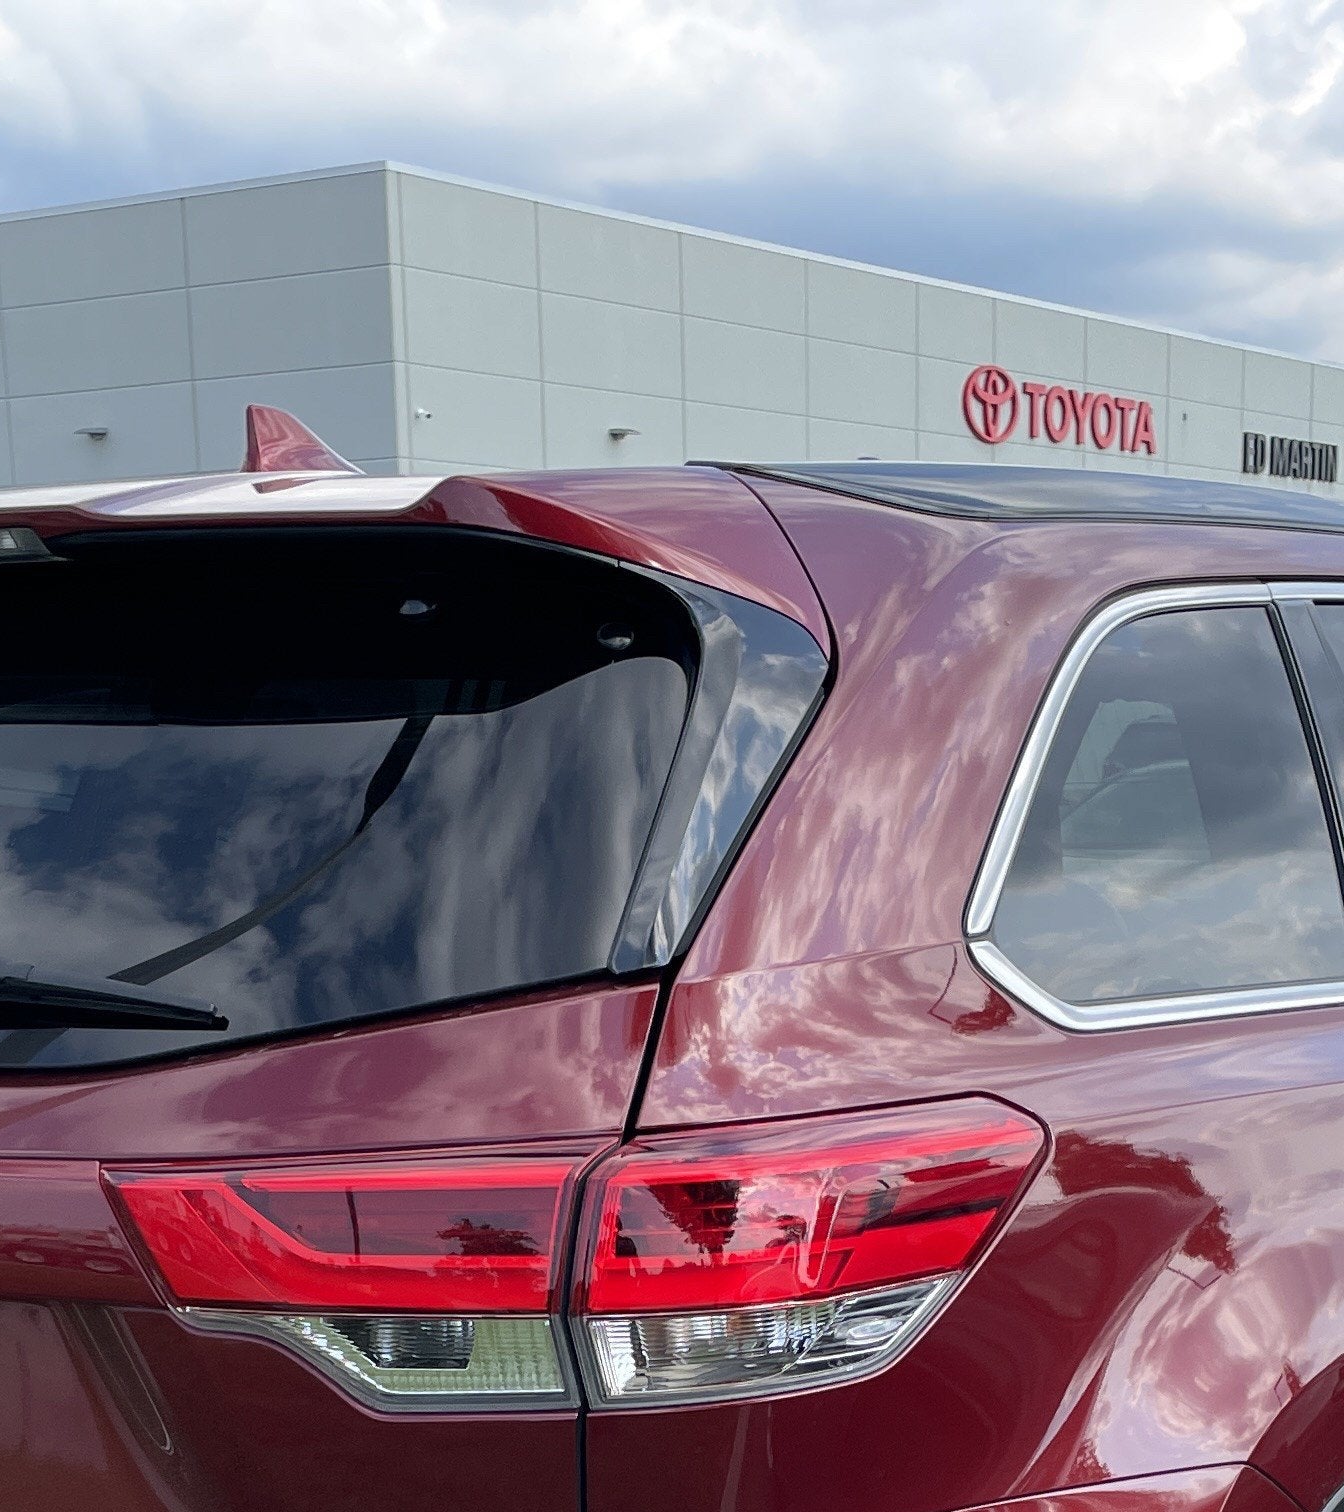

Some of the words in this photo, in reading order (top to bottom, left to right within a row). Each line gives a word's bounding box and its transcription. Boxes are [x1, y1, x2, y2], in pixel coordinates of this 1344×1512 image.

[1022, 381, 1156, 455] TOYOTA
[1242, 431, 1266, 474] ED
[1269, 436, 1338, 482] MARTIN
